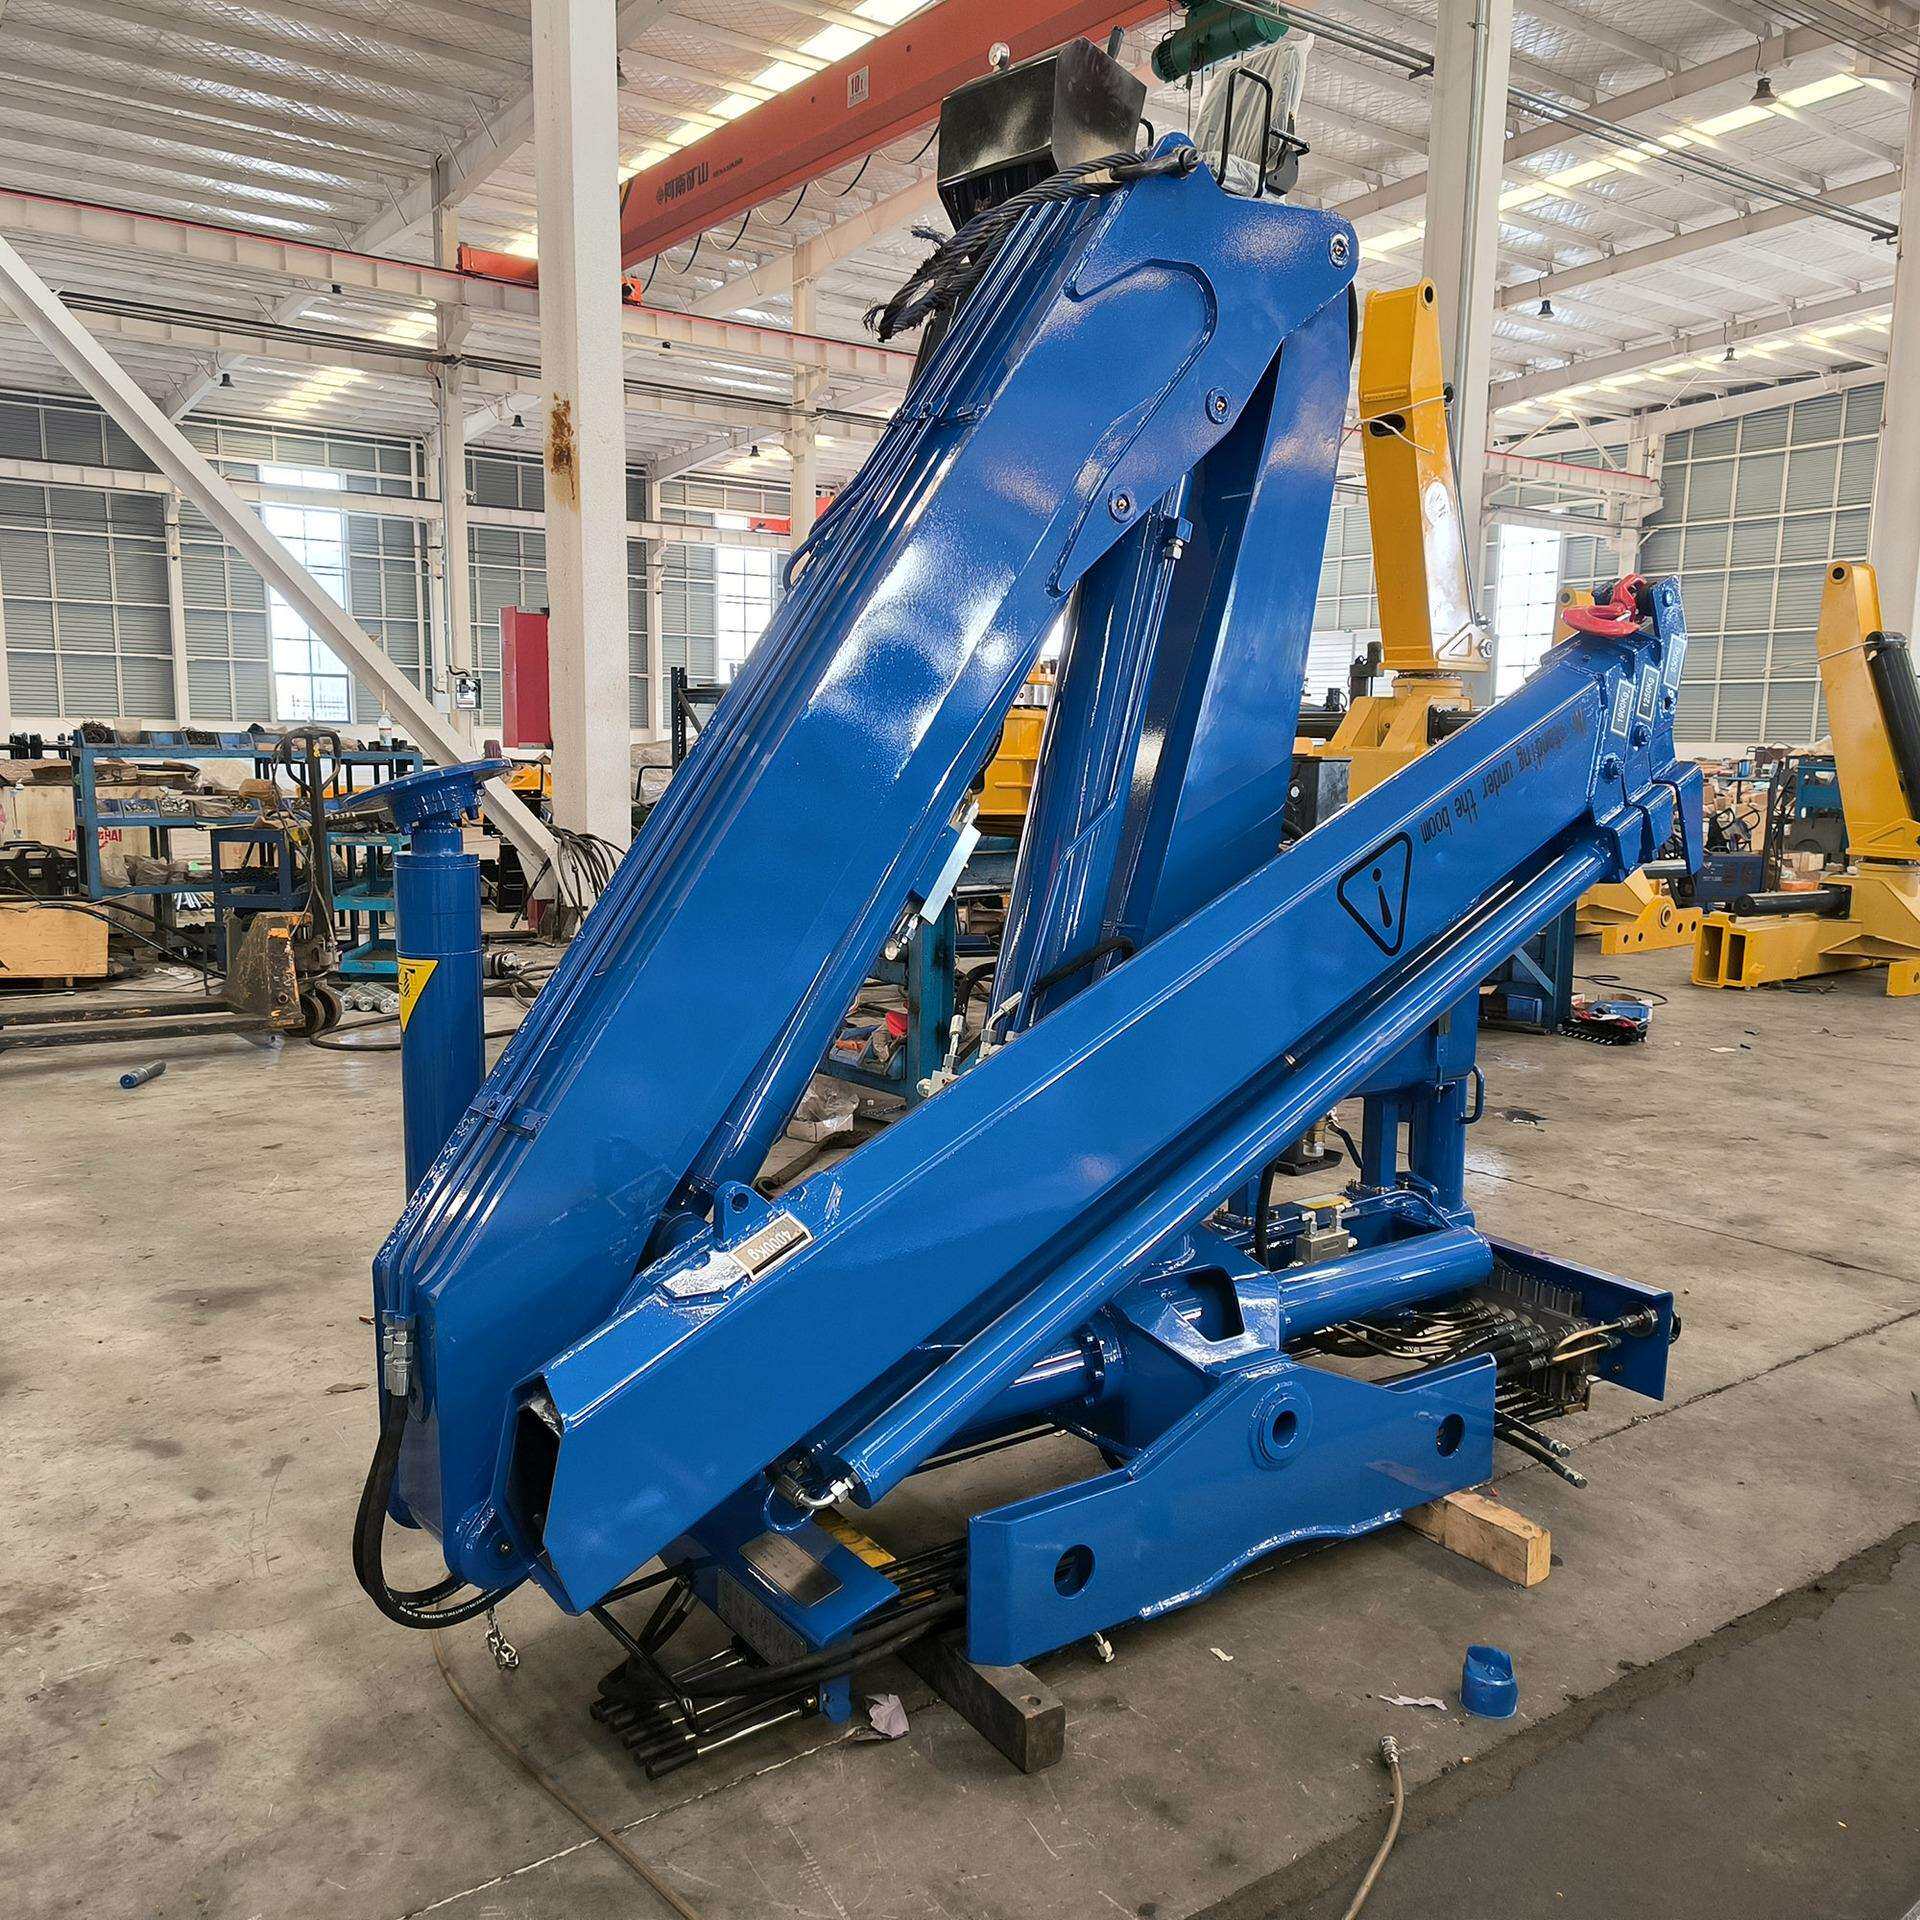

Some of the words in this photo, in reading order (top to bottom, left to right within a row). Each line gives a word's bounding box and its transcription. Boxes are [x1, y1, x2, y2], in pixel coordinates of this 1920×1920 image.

[1642, 677, 1655, 708] 1250Kg
[1483, 760, 1514, 799] under
[1454, 788, 1478, 824] the
[1420, 806, 1453, 844] boom
[747, 1230, 792, 1261] 4000Kg
